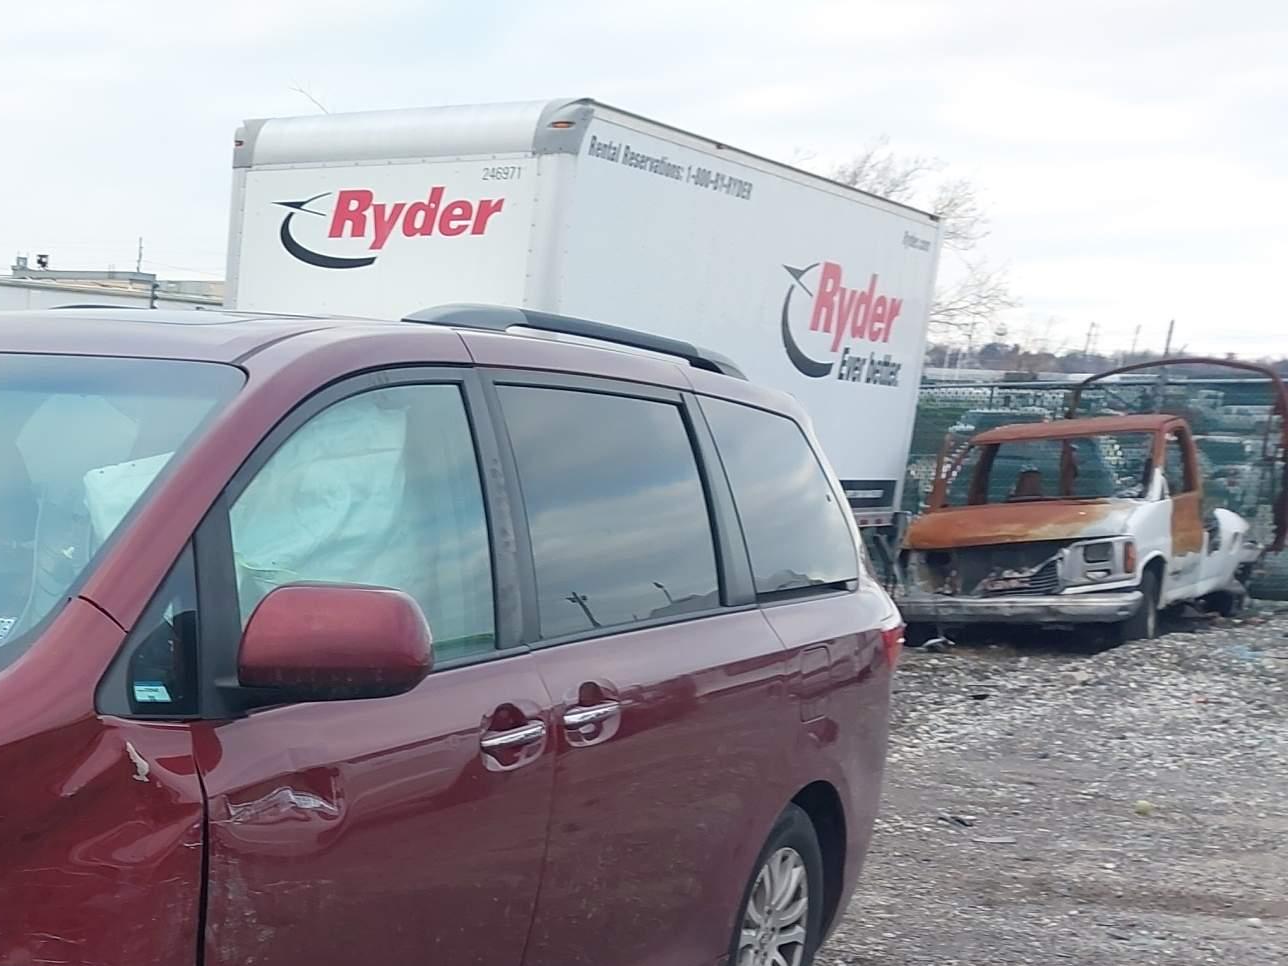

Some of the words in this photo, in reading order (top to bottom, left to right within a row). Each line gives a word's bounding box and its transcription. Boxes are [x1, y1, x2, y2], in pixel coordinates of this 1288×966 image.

[588, 135, 621, 162] Rental
[482, 167, 522, 180] 246971
[328, 187, 505, 250] Ryder
[809, 261, 904, 352] Ryder
[837, 347, 867, 382] Ever
